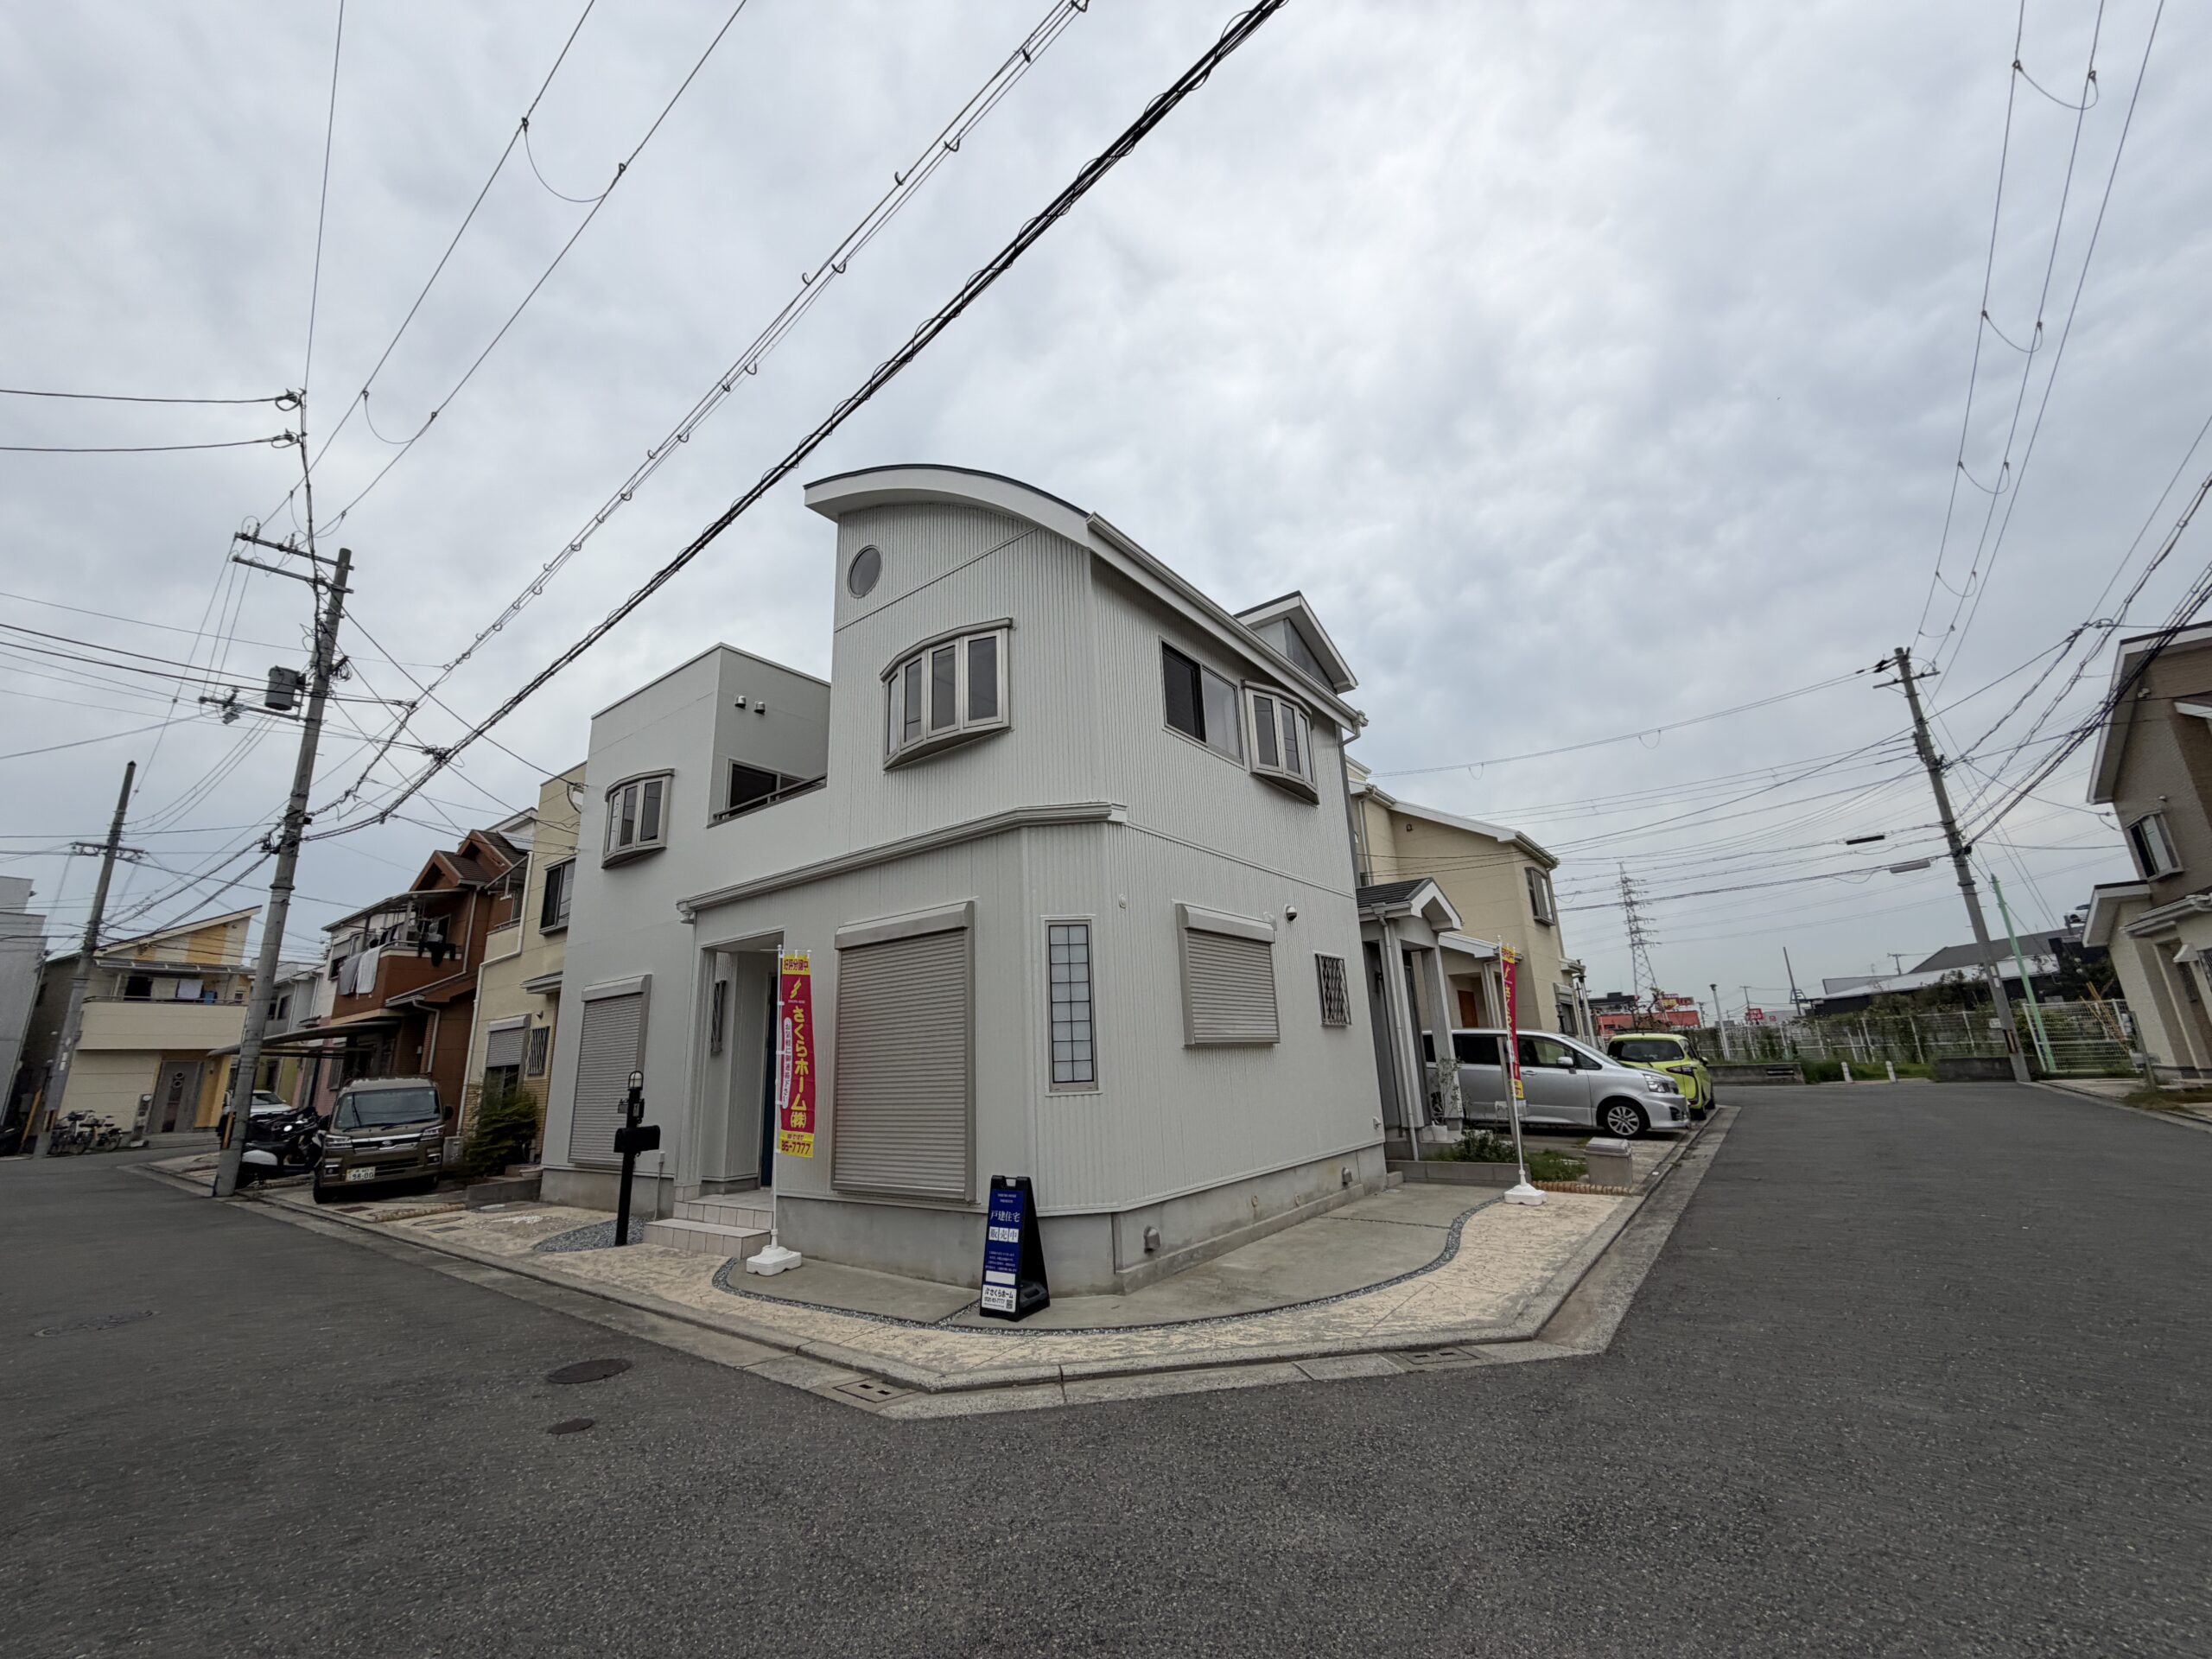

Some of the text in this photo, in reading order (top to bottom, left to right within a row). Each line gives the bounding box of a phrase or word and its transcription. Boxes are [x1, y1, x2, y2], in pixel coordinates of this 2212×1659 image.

[990, 1210, 1020, 1223] 戸建住宅
[990, 1228, 1018, 1241] 販売中
